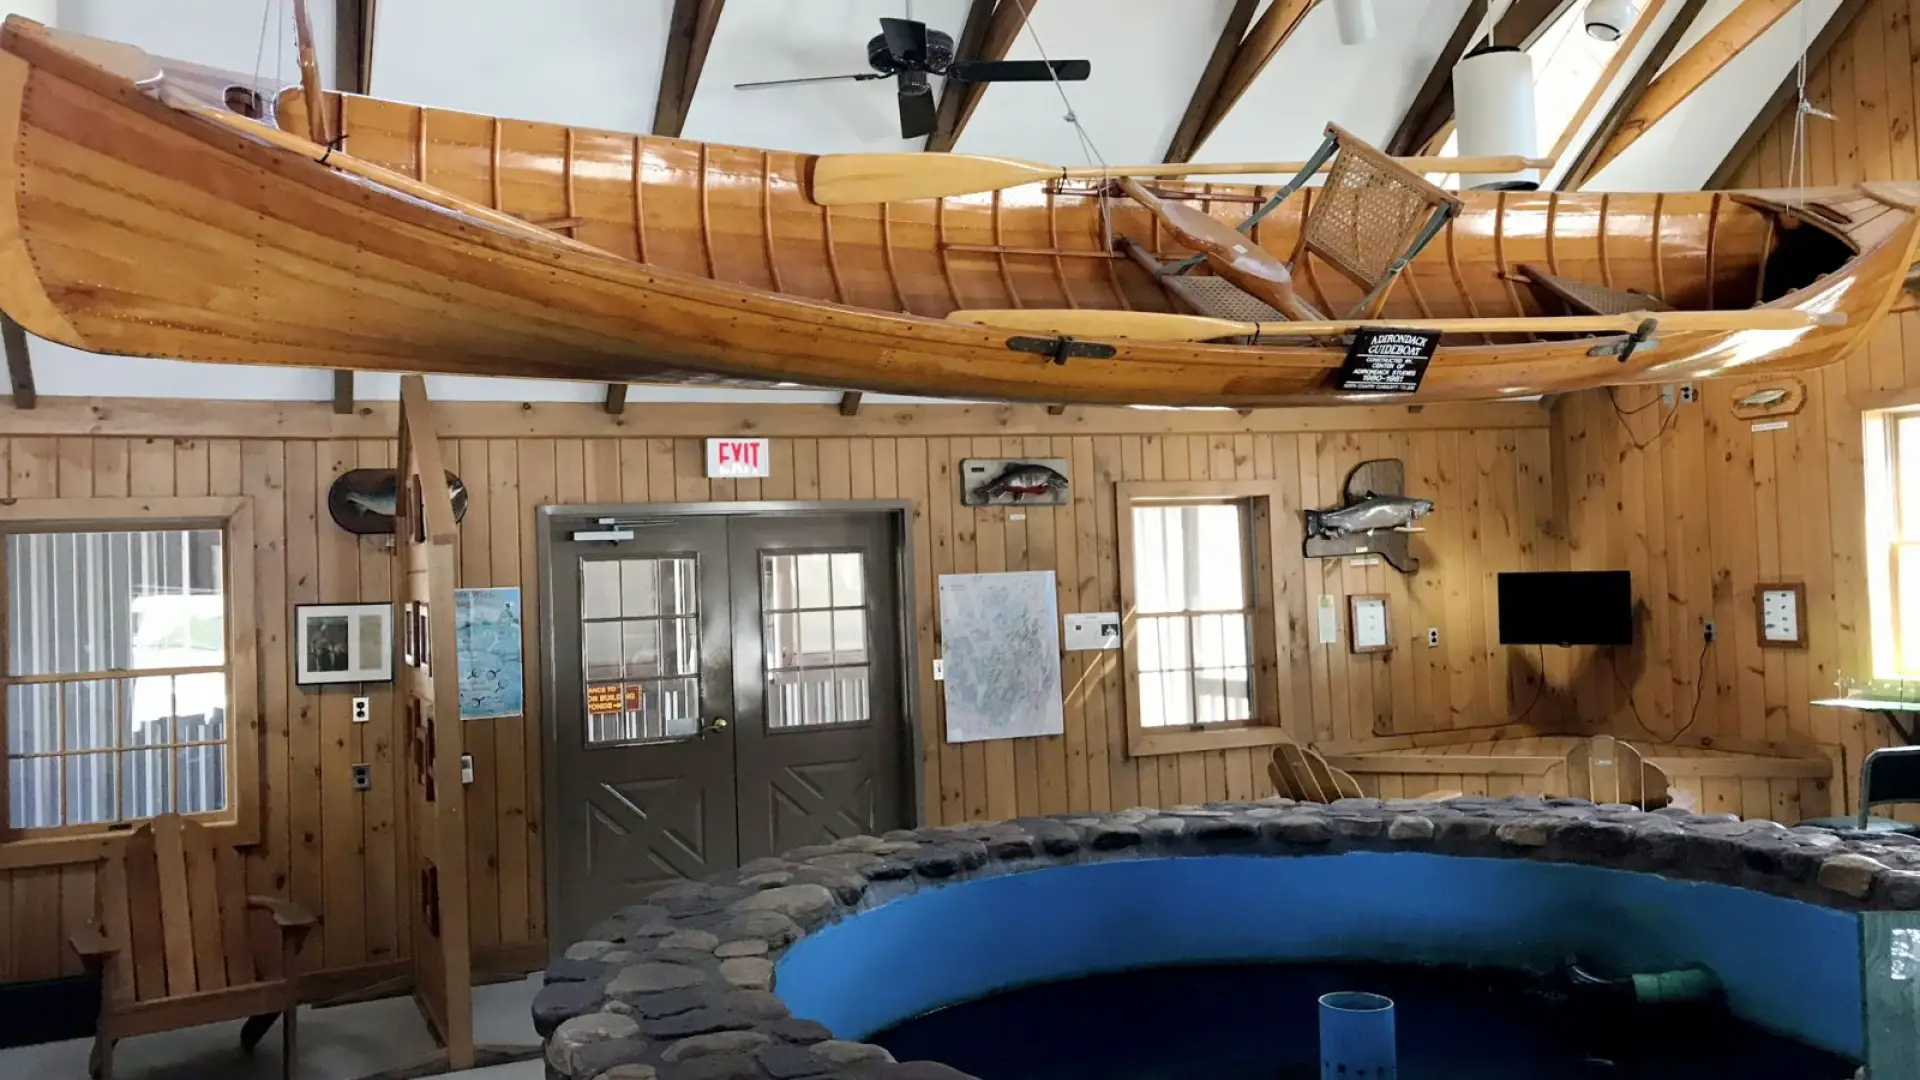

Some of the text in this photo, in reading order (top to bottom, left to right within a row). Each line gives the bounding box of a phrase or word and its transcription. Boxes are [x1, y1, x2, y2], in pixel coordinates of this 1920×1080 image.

[1370, 334, 1428, 347] ADIRONDACK
[1368, 344, 1422, 356] GUIDEBOAT
[1372, 362, 1395, 370] CENTER
[719, 442, 760, 474] EXIT
